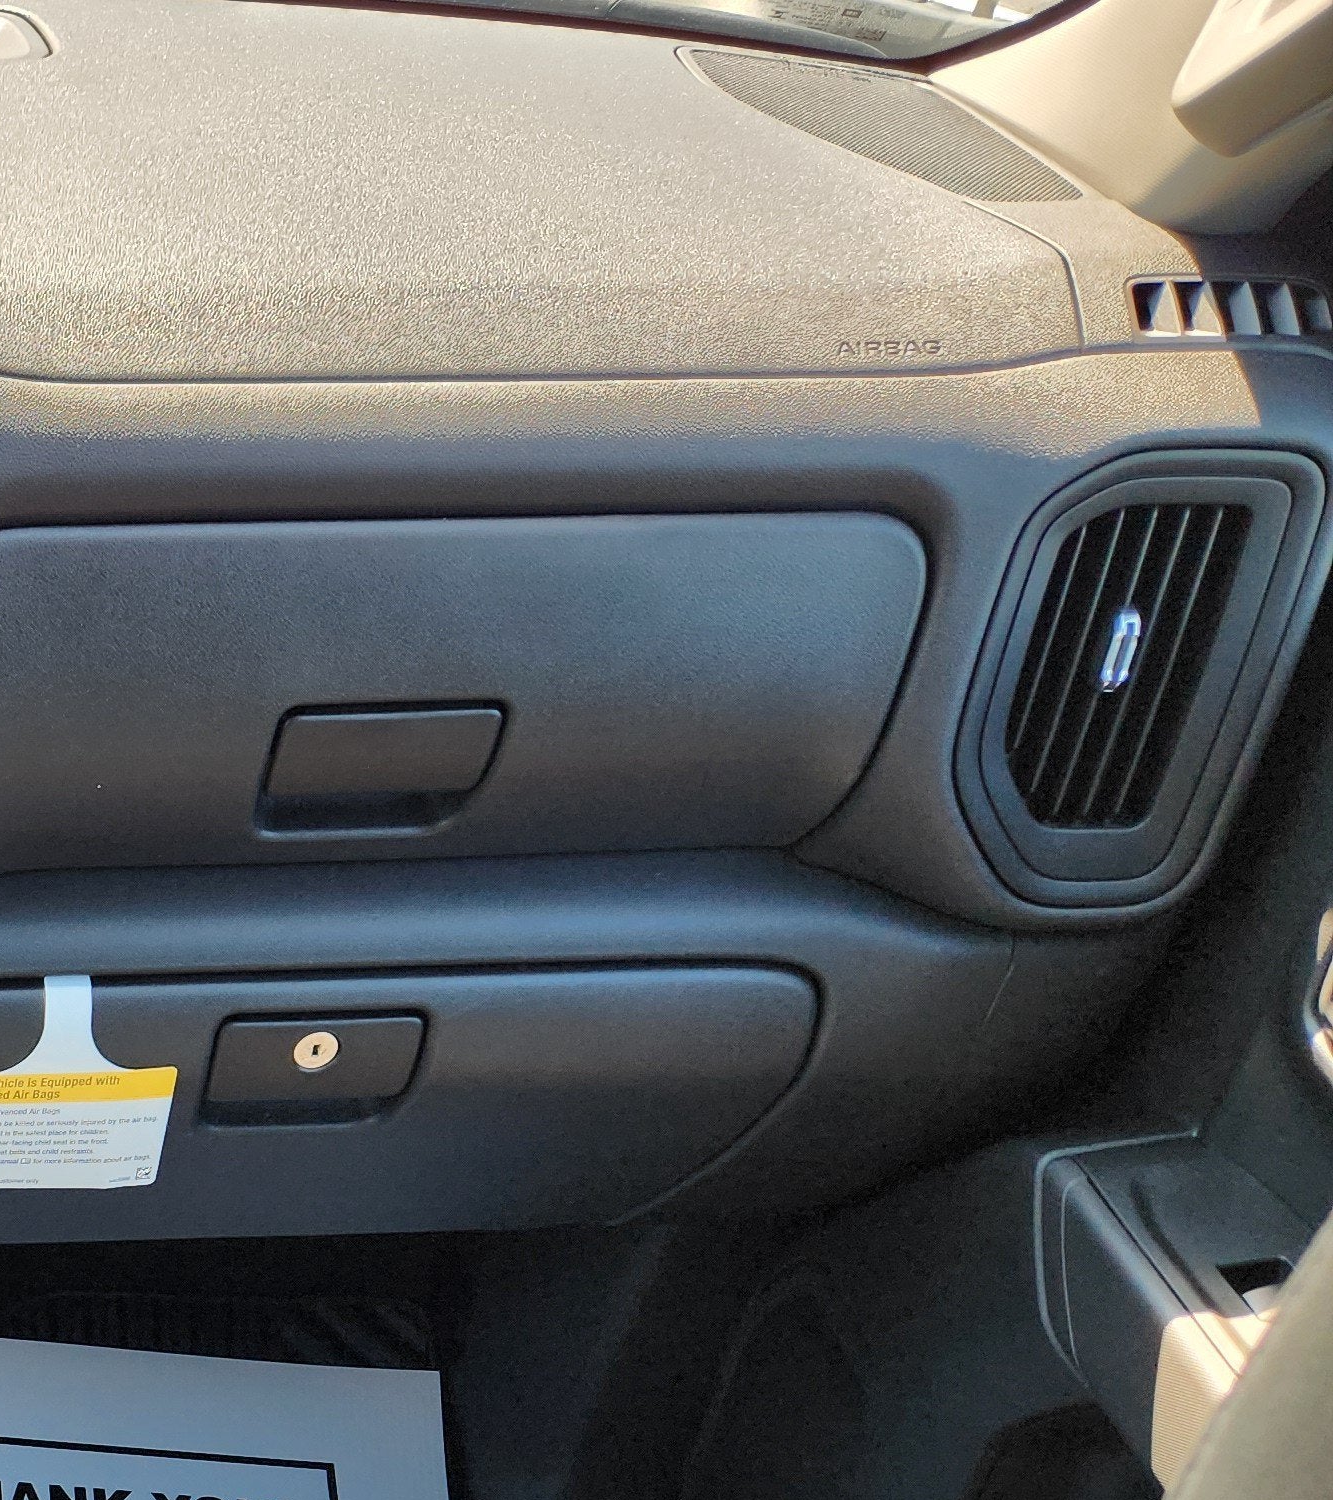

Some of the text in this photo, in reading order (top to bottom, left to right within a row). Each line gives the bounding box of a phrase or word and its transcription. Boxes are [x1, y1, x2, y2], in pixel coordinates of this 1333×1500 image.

[837, 339, 943, 356] AIRBAG
[40, 1076, 92, 1089] Equipped
[96, 1075, 120, 1086] with
[12, 1089, 30, 1100] Air
[32, 1089, 60, 1101] Bags
[41, 1107, 61, 1116] Bags
[46, 1119, 79, 1127] seriously
[80, 1119, 106, 1127] injured
[107, 1118, 117, 1126] by
[41, 1148, 59, 1156] child
[63, 1157, 102, 1165] information
[103, 1156, 122, 1164] about
[123, 1155, 132, 1163] air
